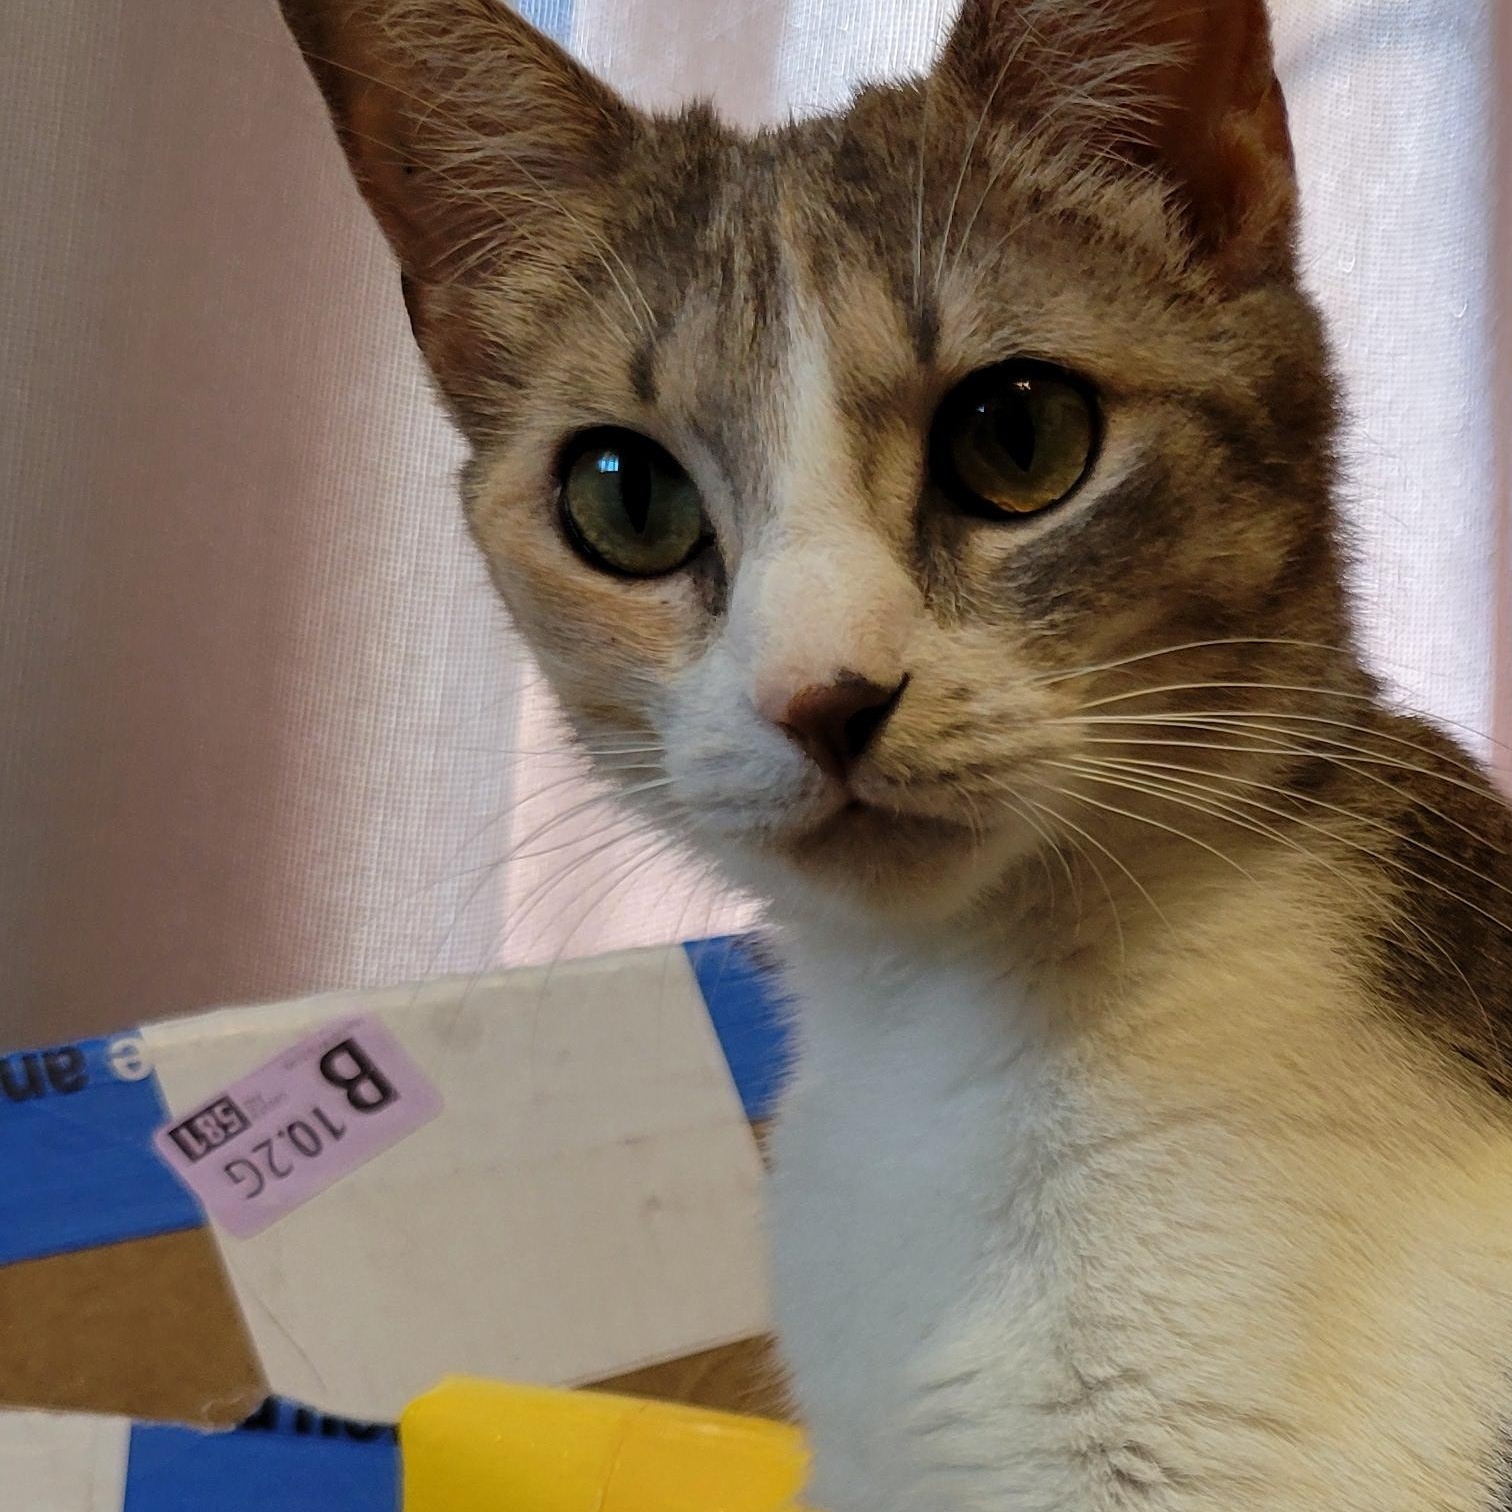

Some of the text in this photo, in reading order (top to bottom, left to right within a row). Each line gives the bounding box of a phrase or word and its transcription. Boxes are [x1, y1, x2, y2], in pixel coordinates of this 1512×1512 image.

[319, 1037, 401, 1117] B
[180, 1103, 238, 1157] 581
[224, 1107, 347, 1200] 10.2G
